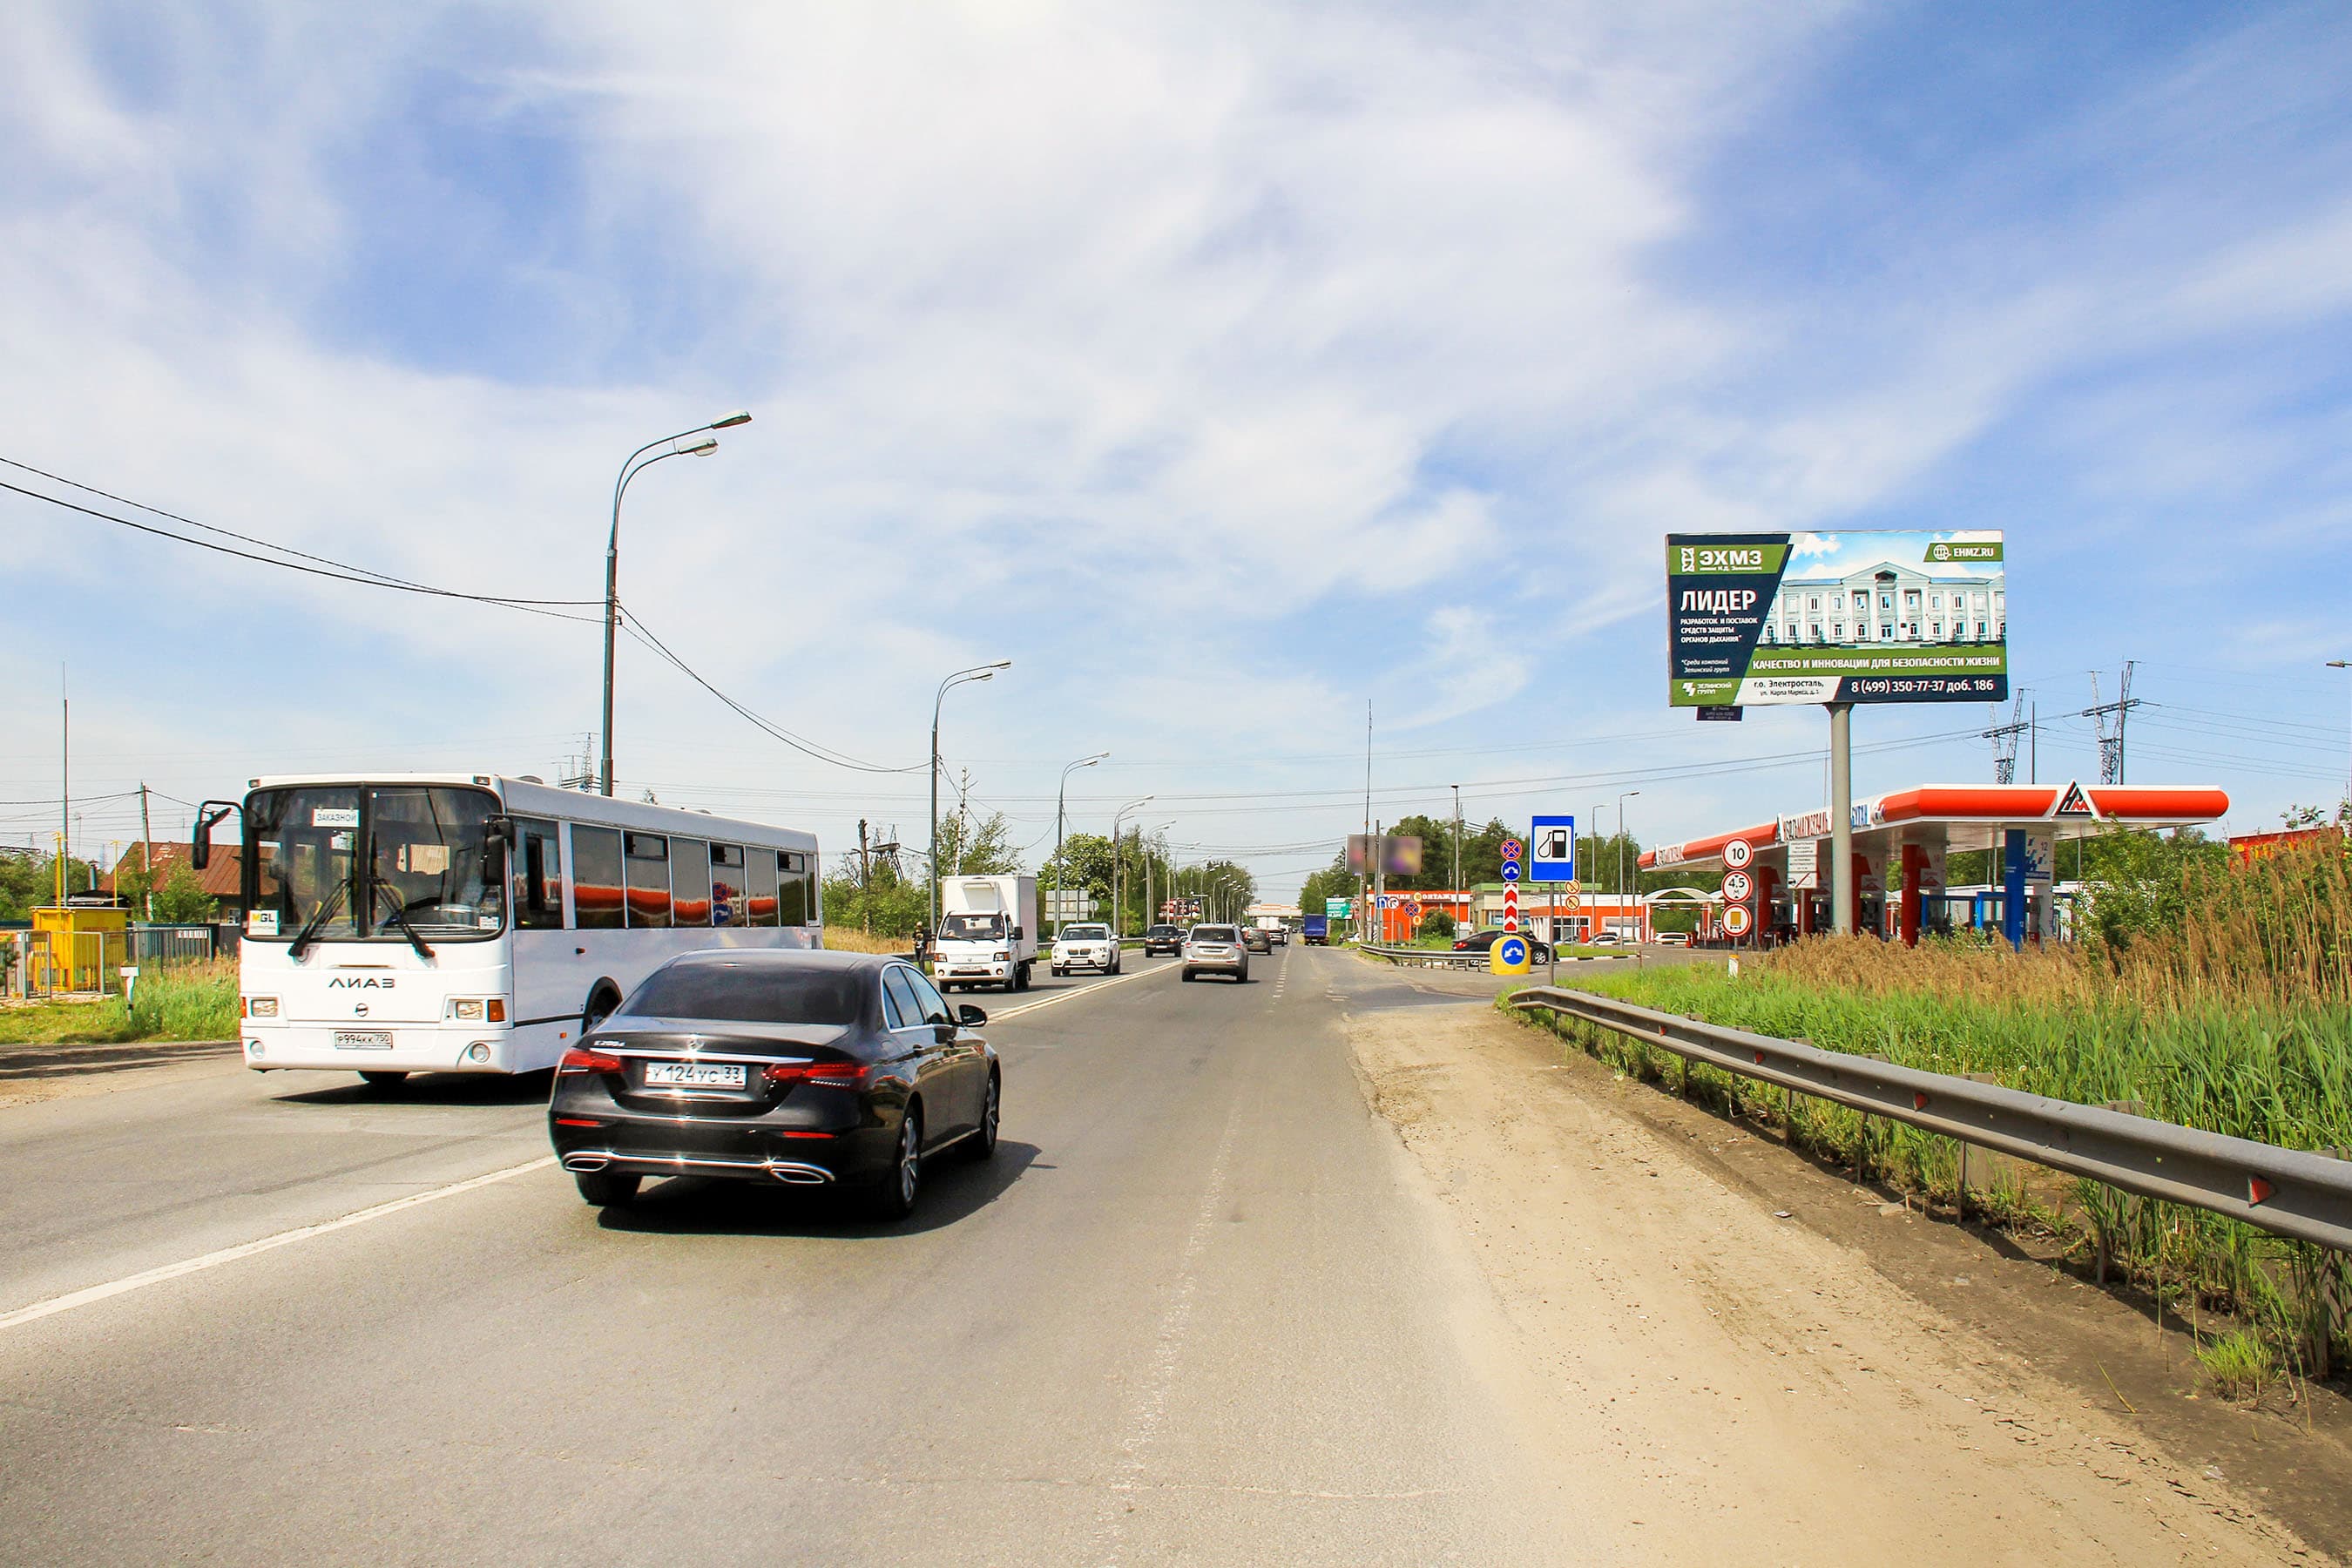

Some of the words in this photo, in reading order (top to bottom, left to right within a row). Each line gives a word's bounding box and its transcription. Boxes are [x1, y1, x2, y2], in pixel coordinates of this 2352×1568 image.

[1700, 550, 1762, 566] ЭХМЗ
[1953, 547, 1995, 558] EHMZ.RU
[1680, 590, 1757, 615] ЛИДЕР
[1752, 659, 1801, 670] КАЧЕСТВО
[1802, 659, 1809, 669] И
[1811, 659, 1869, 670] ИННОВАЦИИ
[1870, 659, 1890, 669] ДЛЯ
[1892, 657, 1963, 668] БЕЗОПАСНОСТИ
[1965, 656, 2000, 666] ЖИЗНИ
[1768, 679, 1824, 688] Электросталь,
[1851, 681, 1859, 693] 8
[1861, 679, 1890, 694] (499)
[1892, 680, 1944, 693] 350-77-37
[1946, 679, 1971, 693] доб.
[1973, 679, 1994, 691] 186
[316, 812, 356, 822] ЗАКАЗНОЙ
[1732, 848, 1745, 860] 10
[252, 913, 274, 923] MGL
[328, 977, 395, 988] ЛИАЗ
[724, 1066, 740, 1079] 33
